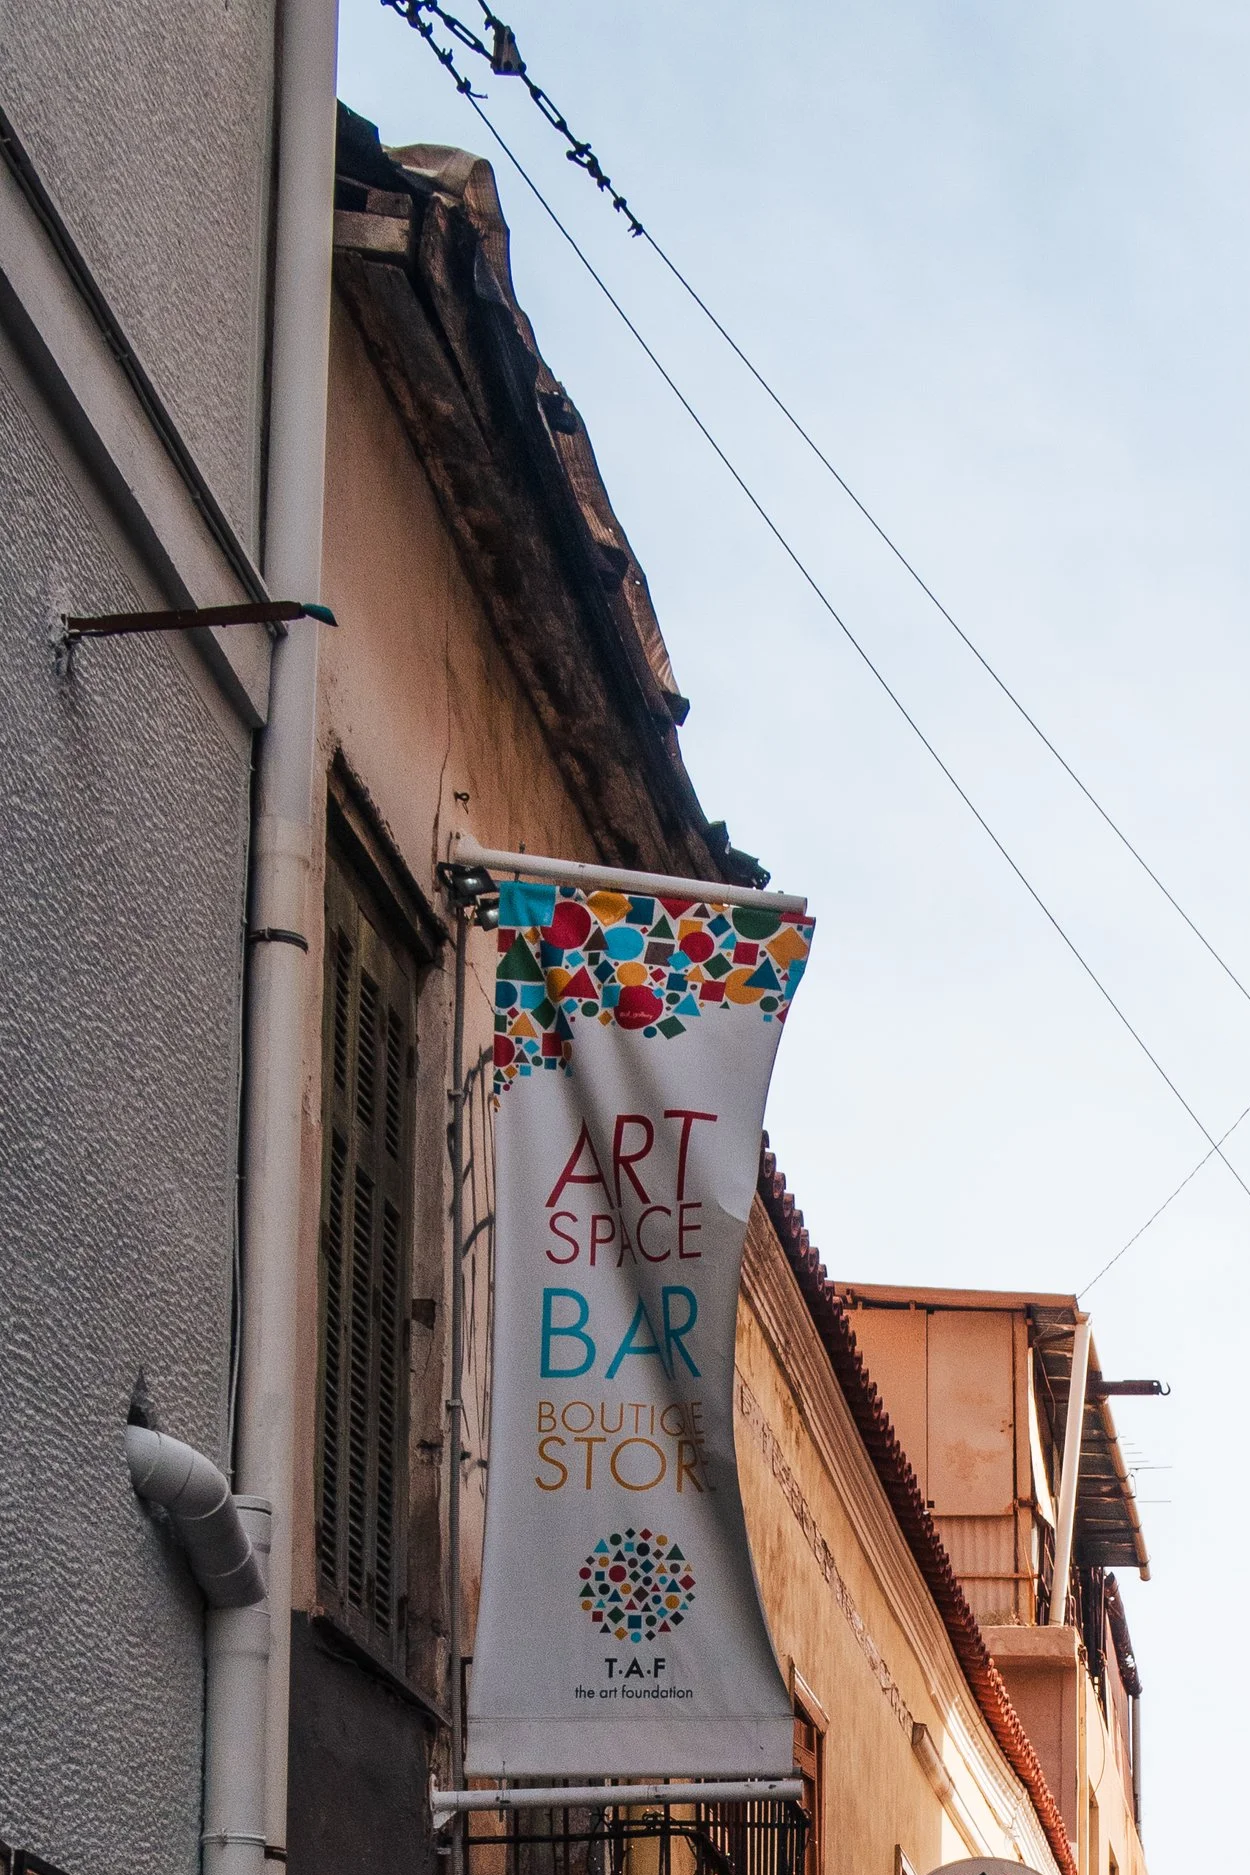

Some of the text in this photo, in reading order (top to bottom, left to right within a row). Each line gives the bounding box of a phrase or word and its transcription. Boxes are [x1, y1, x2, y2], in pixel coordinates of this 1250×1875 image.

[545, 1109, 718, 1209] ART
[545, 1202, 703, 1267] SPACE
[540, 1285, 701, 1380] BAR
[534, 1437, 716, 1493] STORE
[575, 1684, 694, 1700] the art foundation
